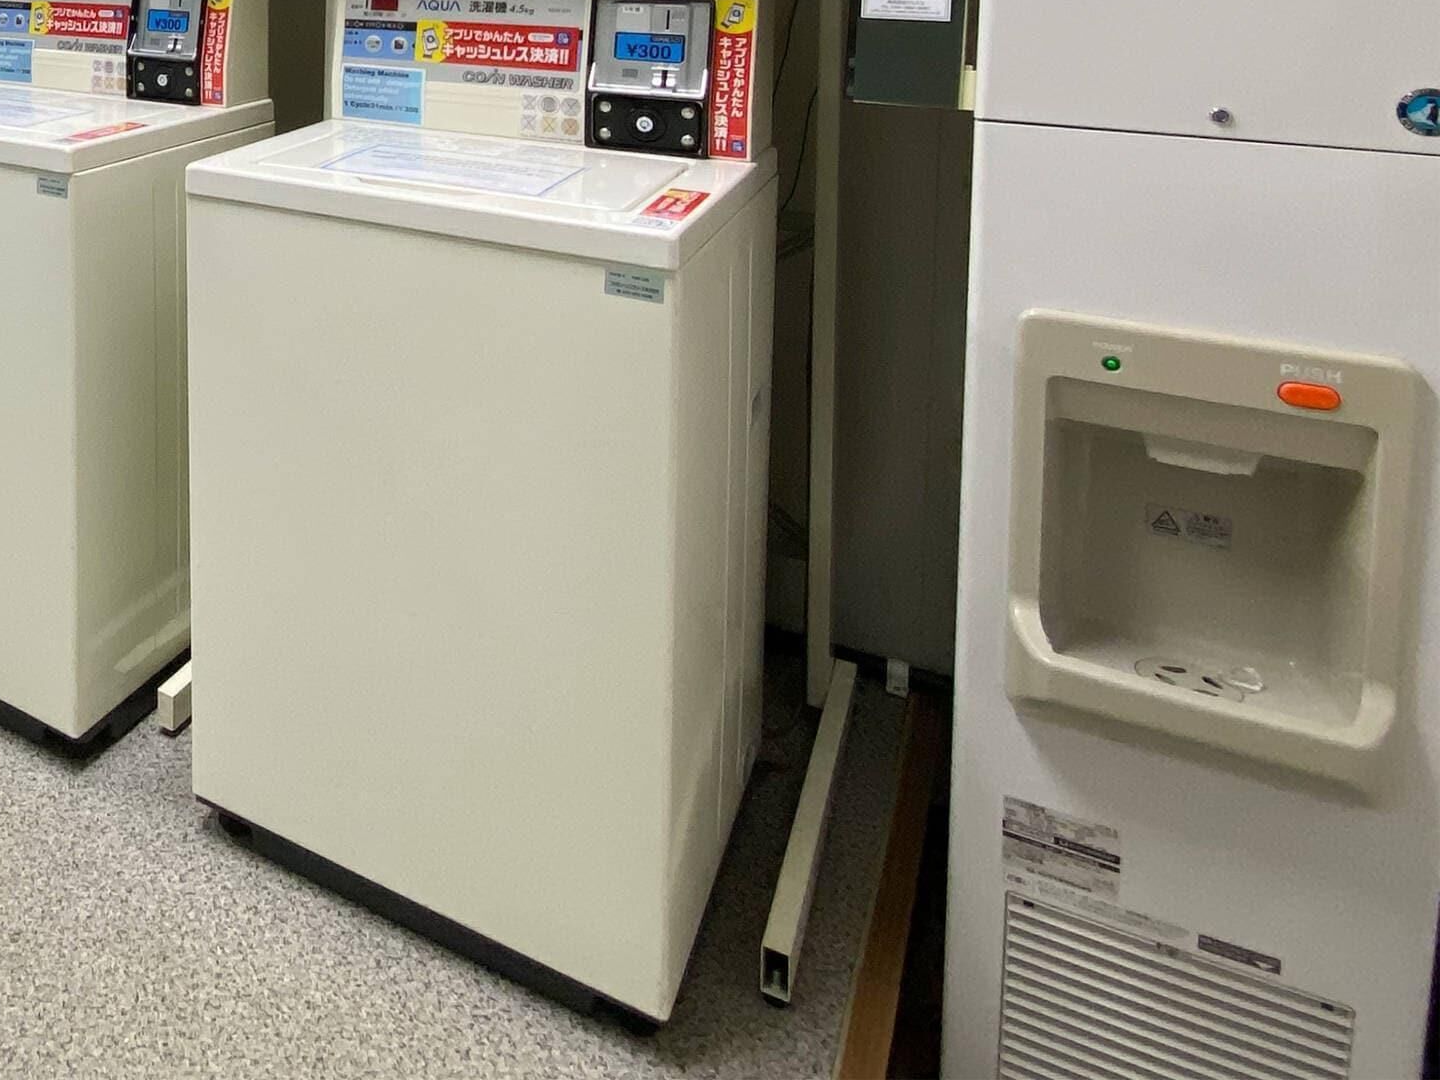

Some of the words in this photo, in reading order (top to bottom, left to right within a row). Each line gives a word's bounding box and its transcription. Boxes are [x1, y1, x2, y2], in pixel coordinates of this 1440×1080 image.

[417, 0, 461, 12] AQUA
[468, 0, 507, 14] 洗濯機
[509, 3, 535, 16] 4.5kg
[155, 18, 181, 30] ¥300
[442, 28, 525, 43] アプリでかんたん
[626, 43, 672, 59] ¥300
[377, 70, 409, 78] Machine
[731, 37, 747, 118] アプリでかんたん
[510, 75, 574, 90] WASHER
[1279, 363, 1343, 384] PUSH
